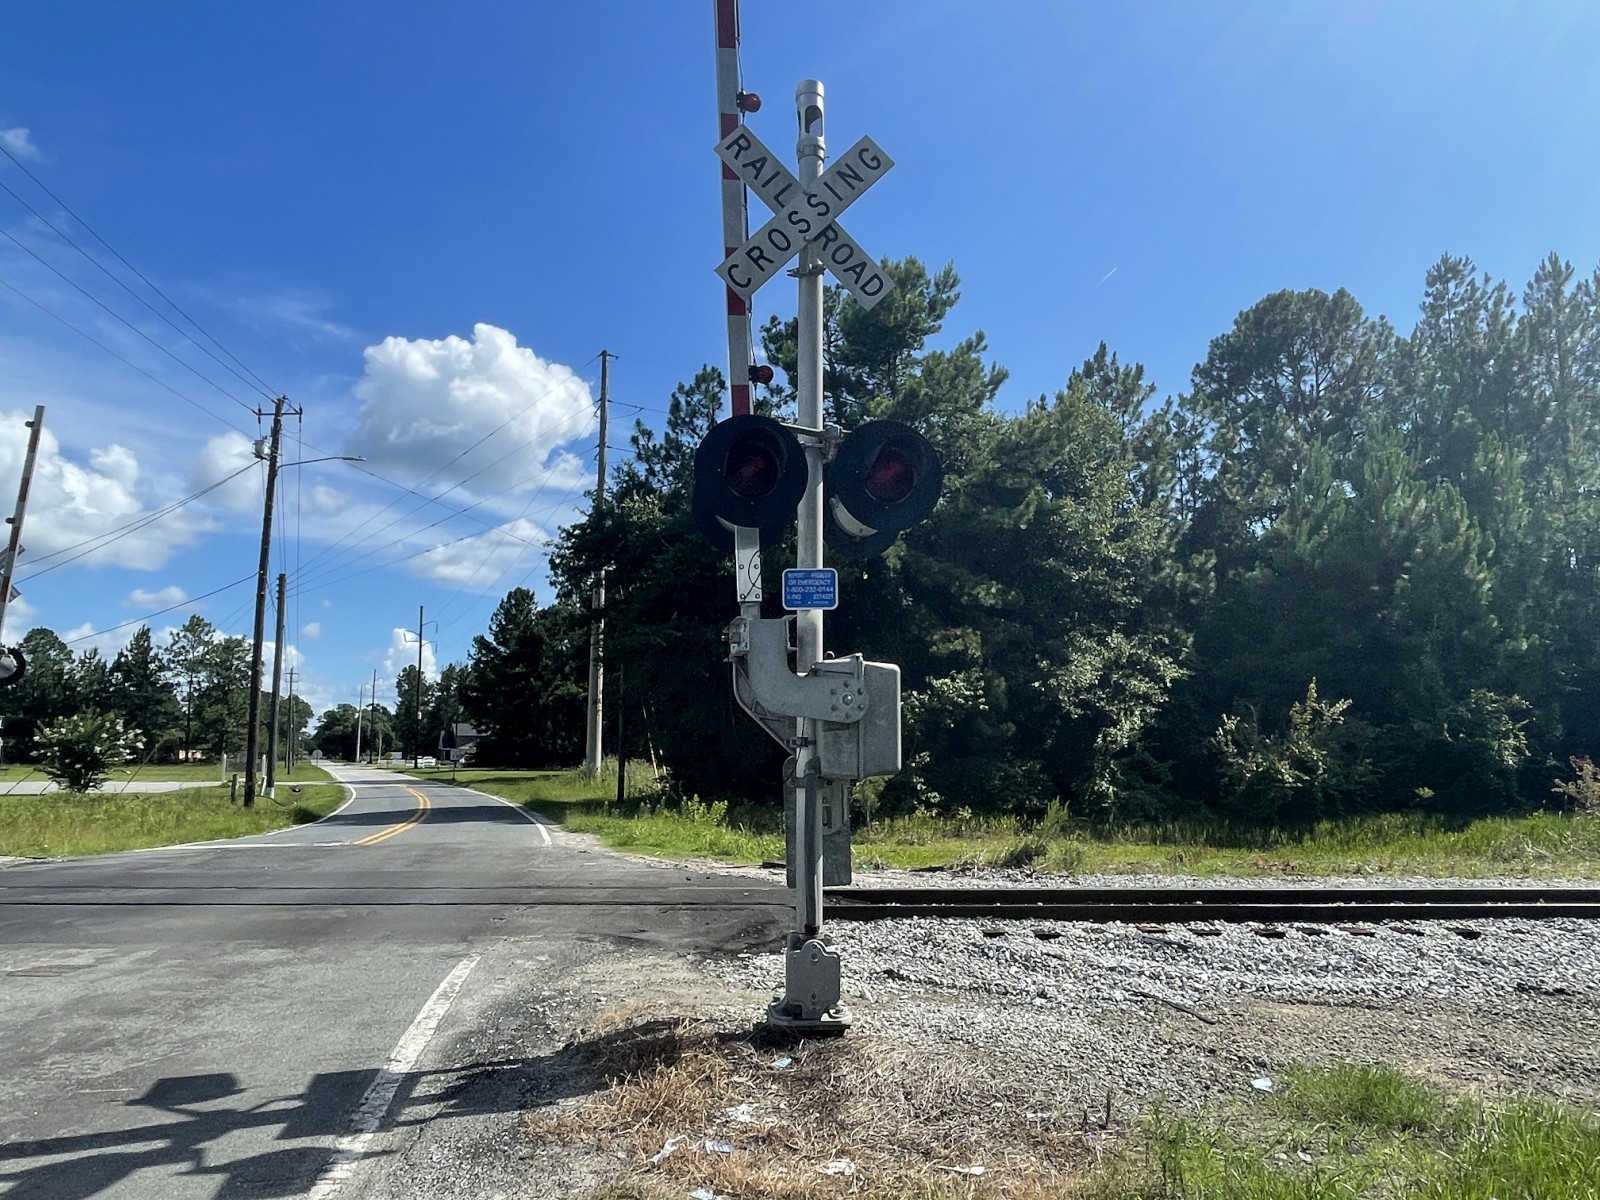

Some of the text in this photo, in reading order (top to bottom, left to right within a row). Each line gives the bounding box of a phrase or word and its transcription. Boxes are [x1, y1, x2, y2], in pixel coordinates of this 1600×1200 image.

[725, 133, 884, 297] RAIL ROAD
[727, 147, 882, 289] CROSSING
